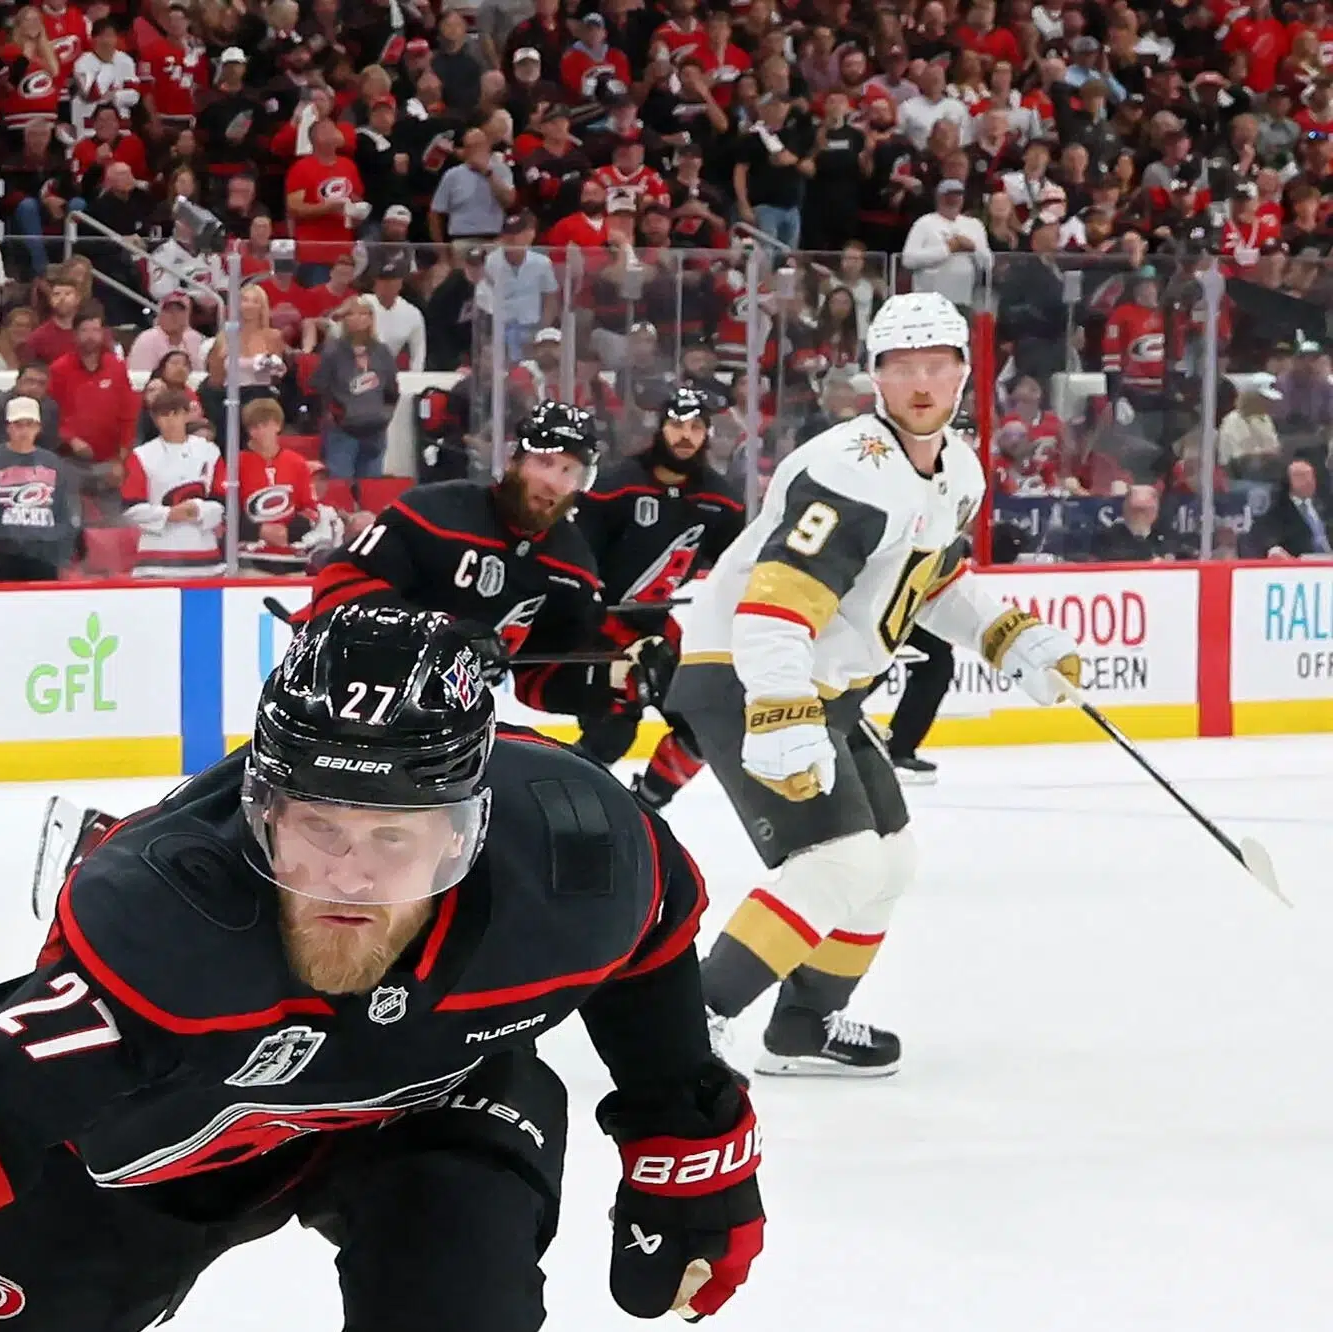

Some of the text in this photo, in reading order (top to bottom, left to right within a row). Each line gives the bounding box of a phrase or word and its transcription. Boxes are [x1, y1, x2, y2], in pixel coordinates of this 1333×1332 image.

[347, 524, 387, 556] 11
[786, 500, 840, 556] 9
[453, 549, 478, 589] C
[25, 634, 118, 714] GFL
[339, 681, 397, 726] 27
[314, 755, 393, 776] BAUER
[465, 1012, 547, 1045] NUCOR
